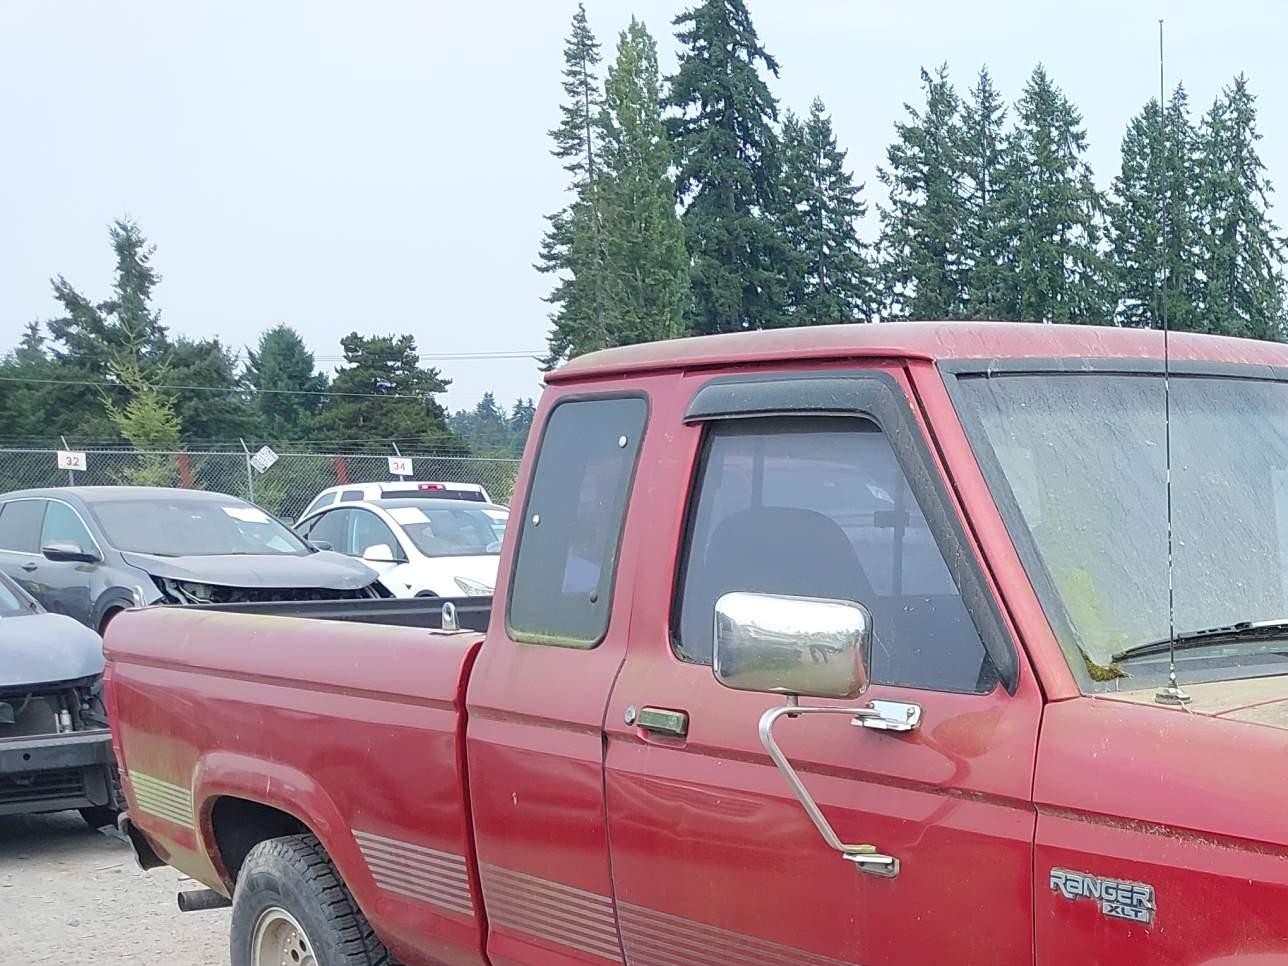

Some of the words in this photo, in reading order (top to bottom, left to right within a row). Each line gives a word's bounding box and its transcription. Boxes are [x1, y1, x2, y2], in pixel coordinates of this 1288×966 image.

[65, 456, 81, 467] 32
[1049, 868, 1156, 911] RANGER
[1107, 904, 1143, 919] XLT
